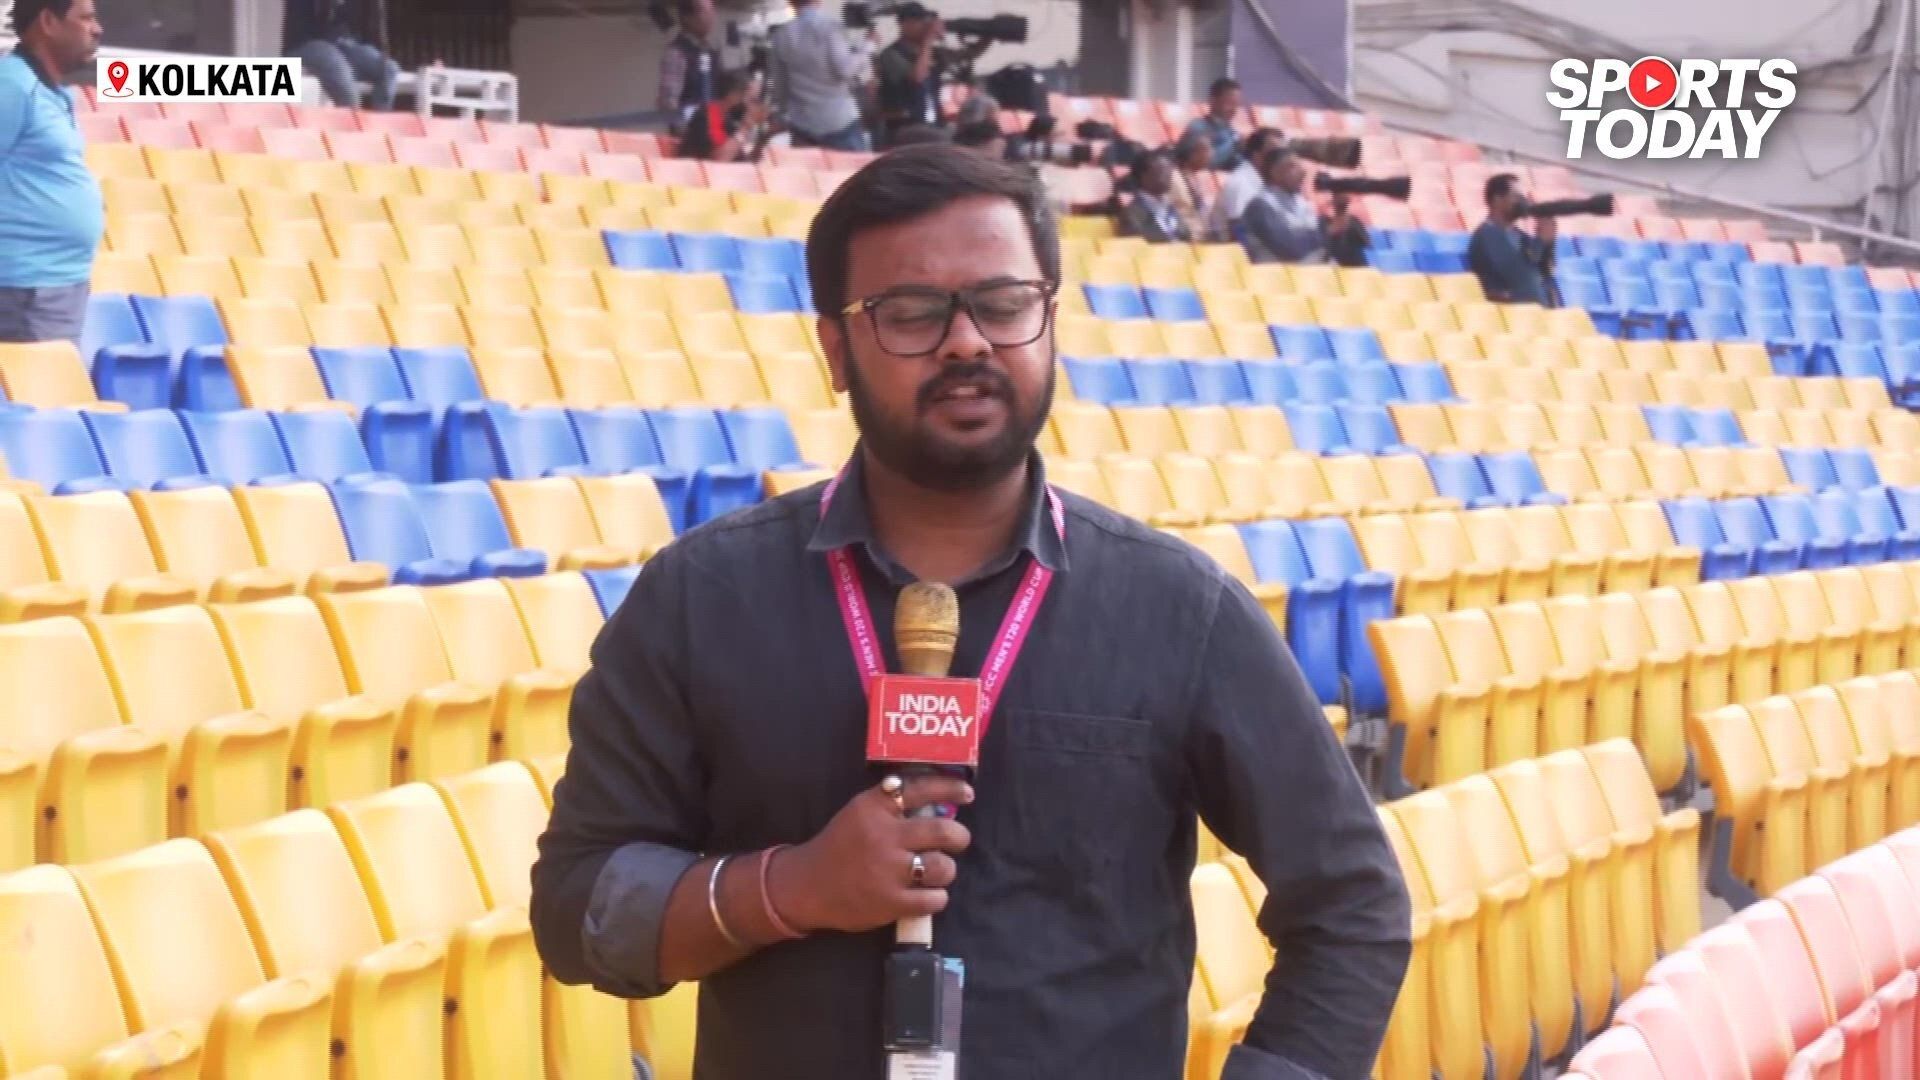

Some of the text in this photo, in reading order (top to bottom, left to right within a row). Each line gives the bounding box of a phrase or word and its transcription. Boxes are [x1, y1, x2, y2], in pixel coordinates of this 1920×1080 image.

[984, 567, 1043, 692] ICC MEN'S T20 WORLD CUP
[899, 693, 961, 714] INDIA
[885, 711, 974, 737] TODAY
